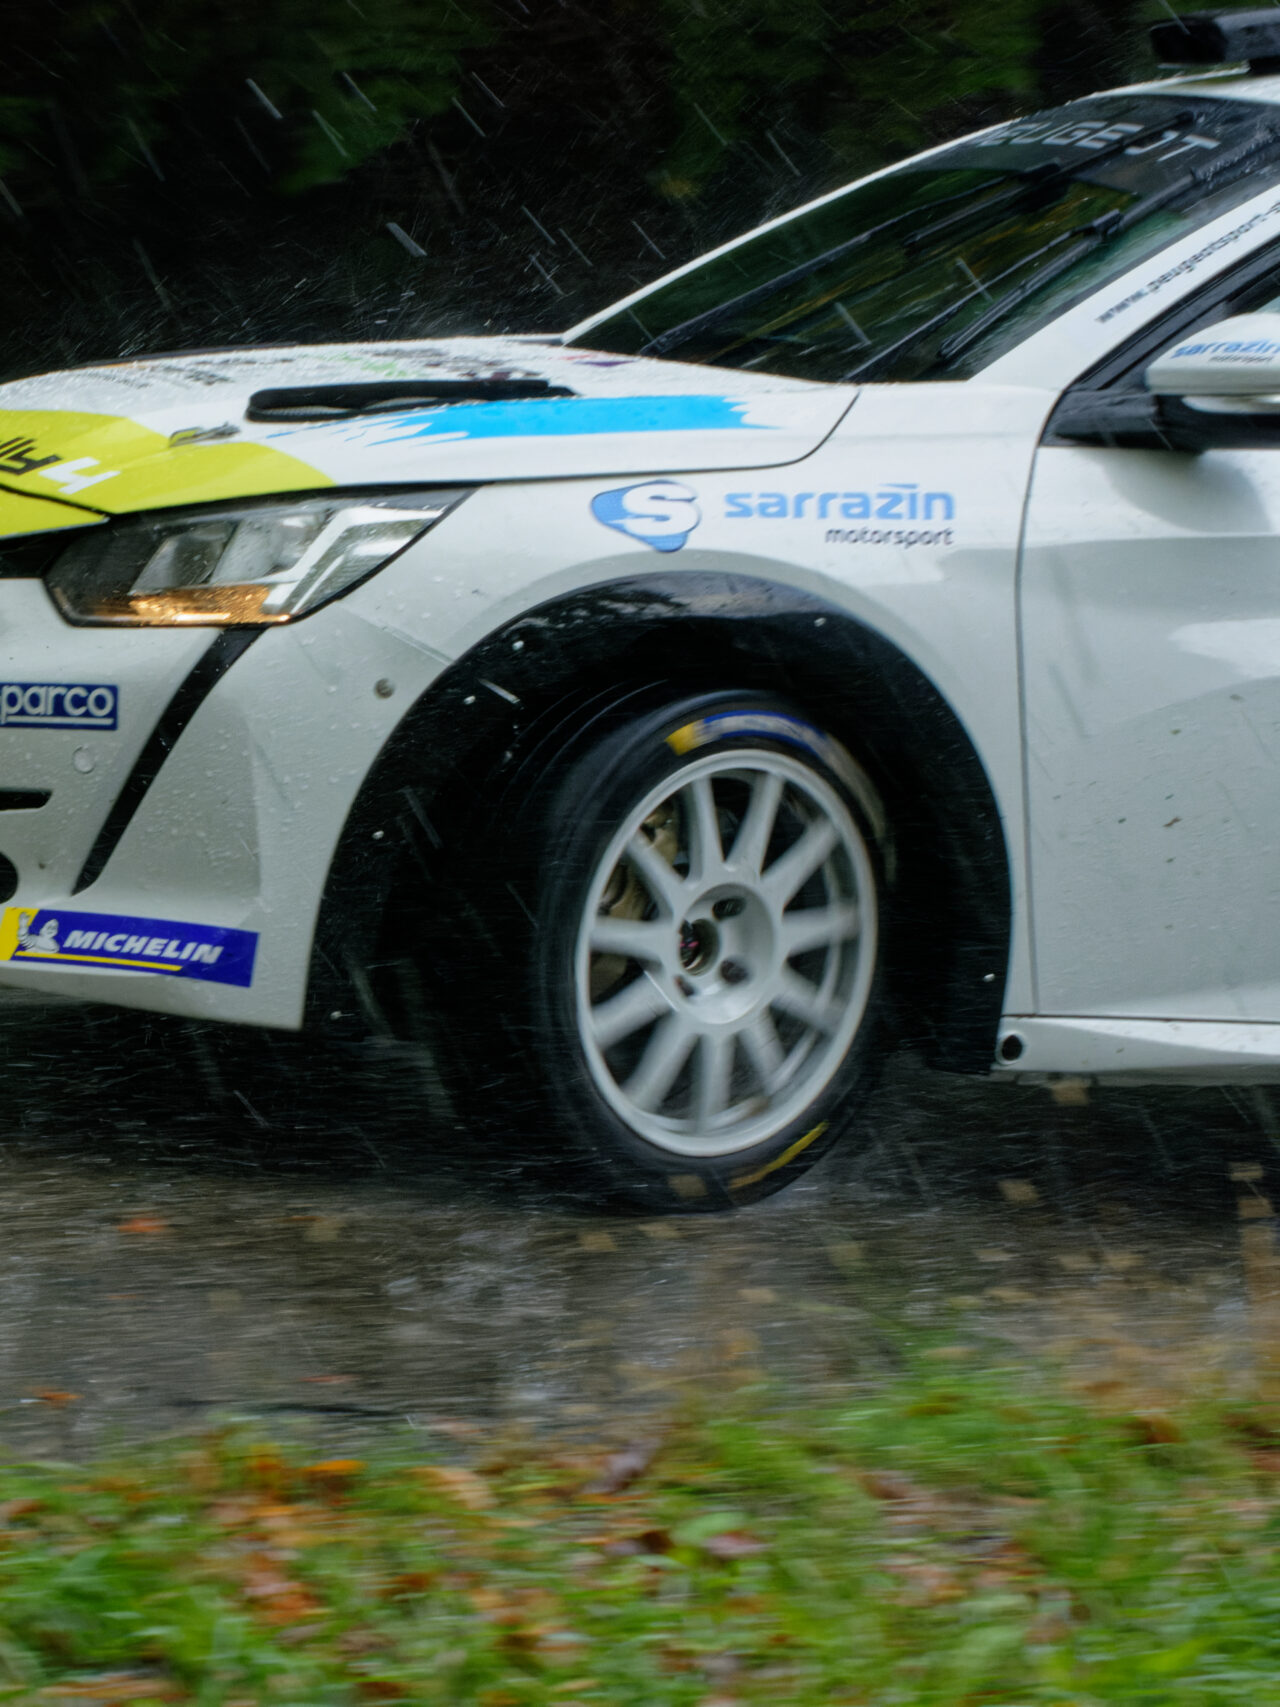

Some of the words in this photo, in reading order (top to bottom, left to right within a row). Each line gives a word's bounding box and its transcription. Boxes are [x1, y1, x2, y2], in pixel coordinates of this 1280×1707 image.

[724, 483, 955, 520] sarrazin
[825, 526, 954, 548] motorsport
[62, 929, 224, 964] MICHELIN
